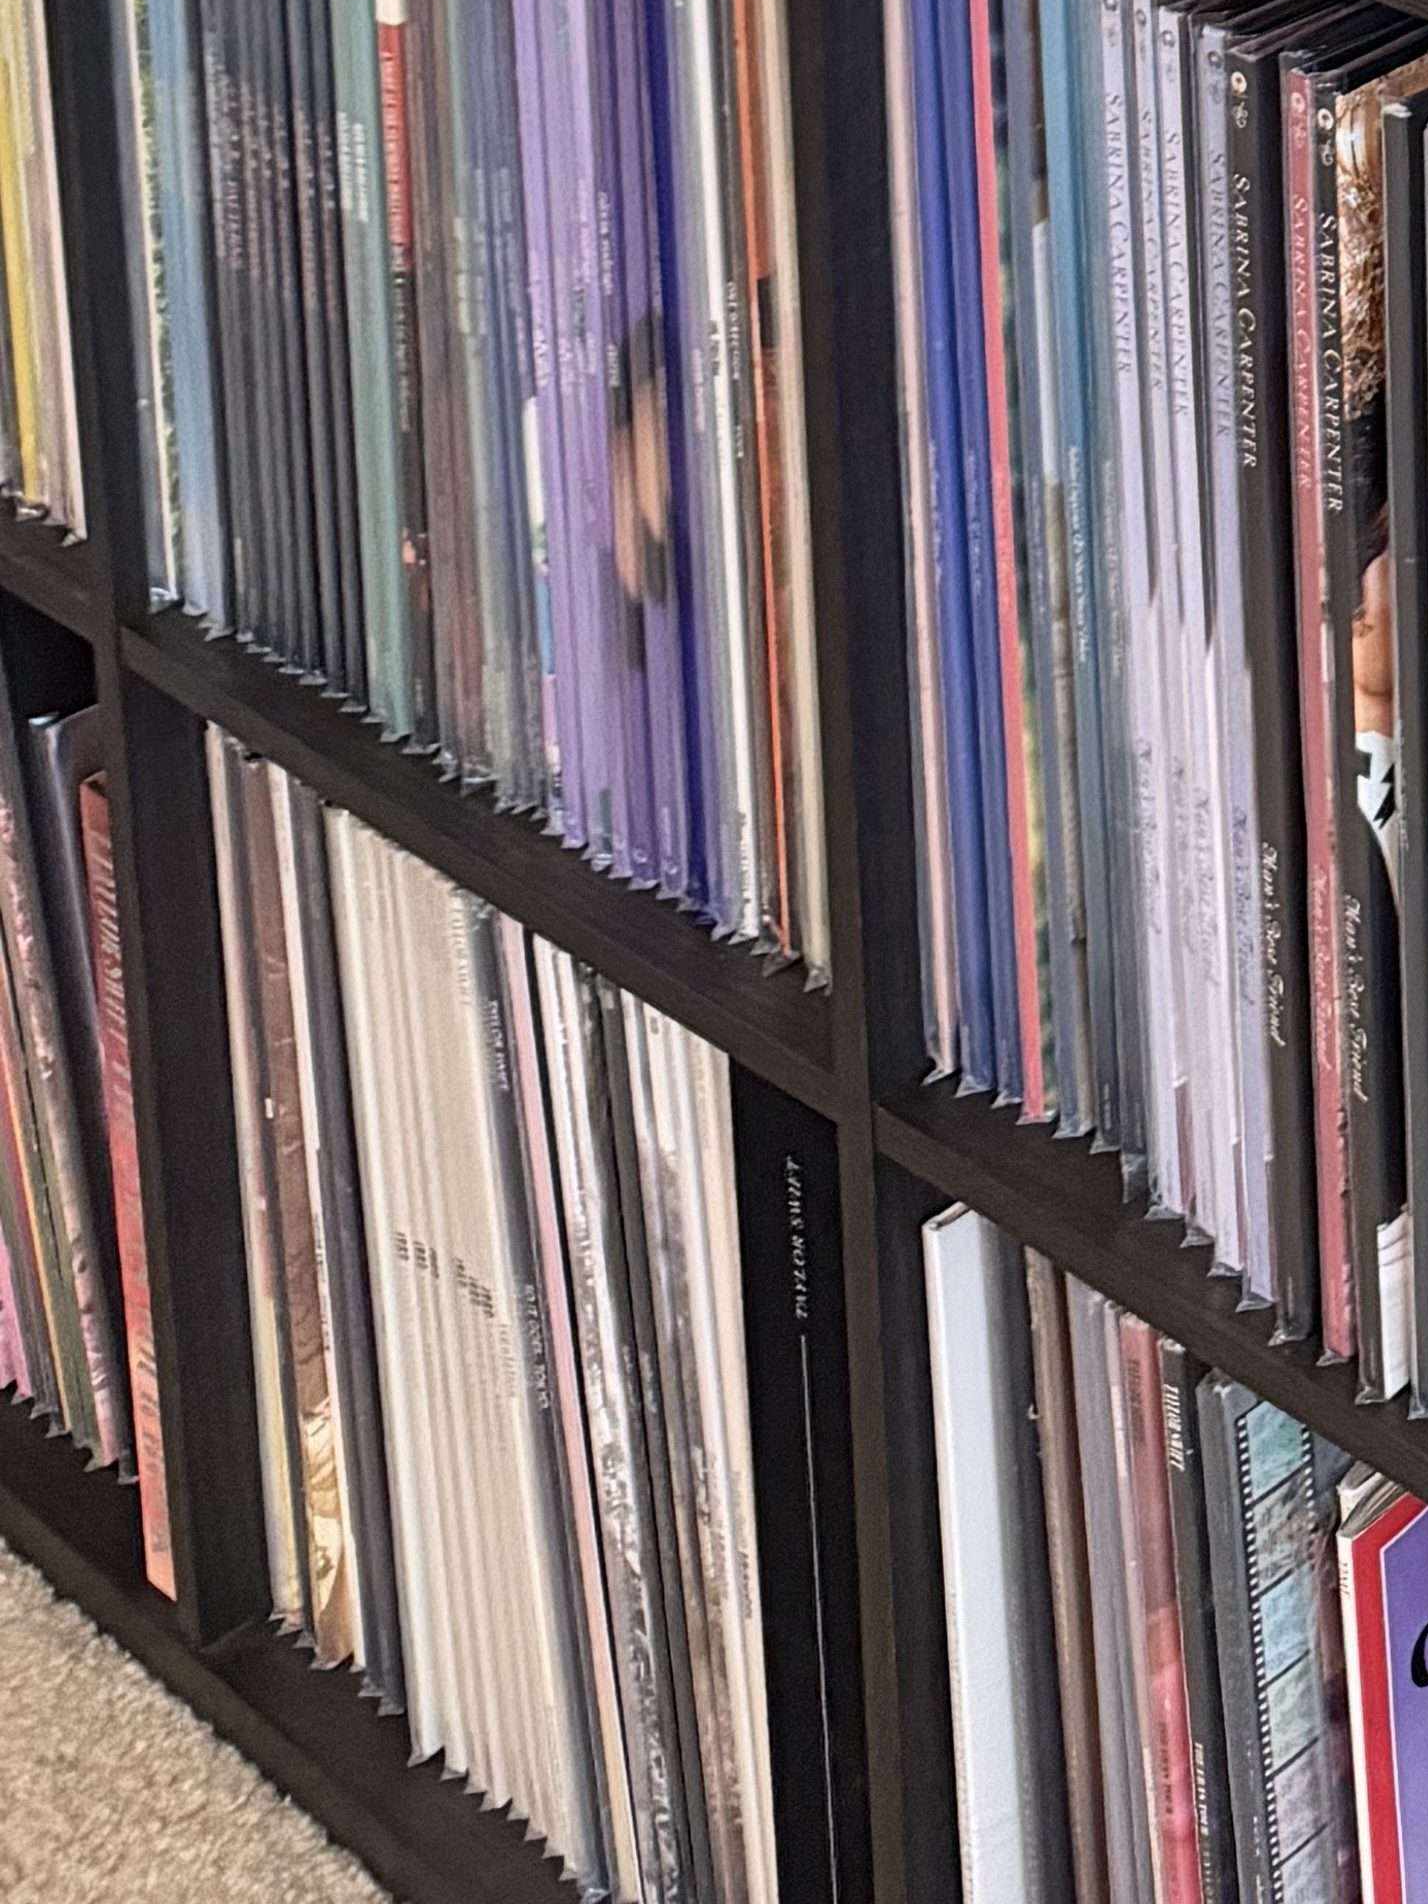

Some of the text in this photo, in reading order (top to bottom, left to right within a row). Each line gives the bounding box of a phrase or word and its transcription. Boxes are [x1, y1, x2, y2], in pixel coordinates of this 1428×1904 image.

[1104, 92, 1135, 374] SABRINA CARPENTER
[1231, 174, 1261, 467] SABRINA CARPENTER
[1317, 212, 1347, 512] SABRINA CARPENTER
